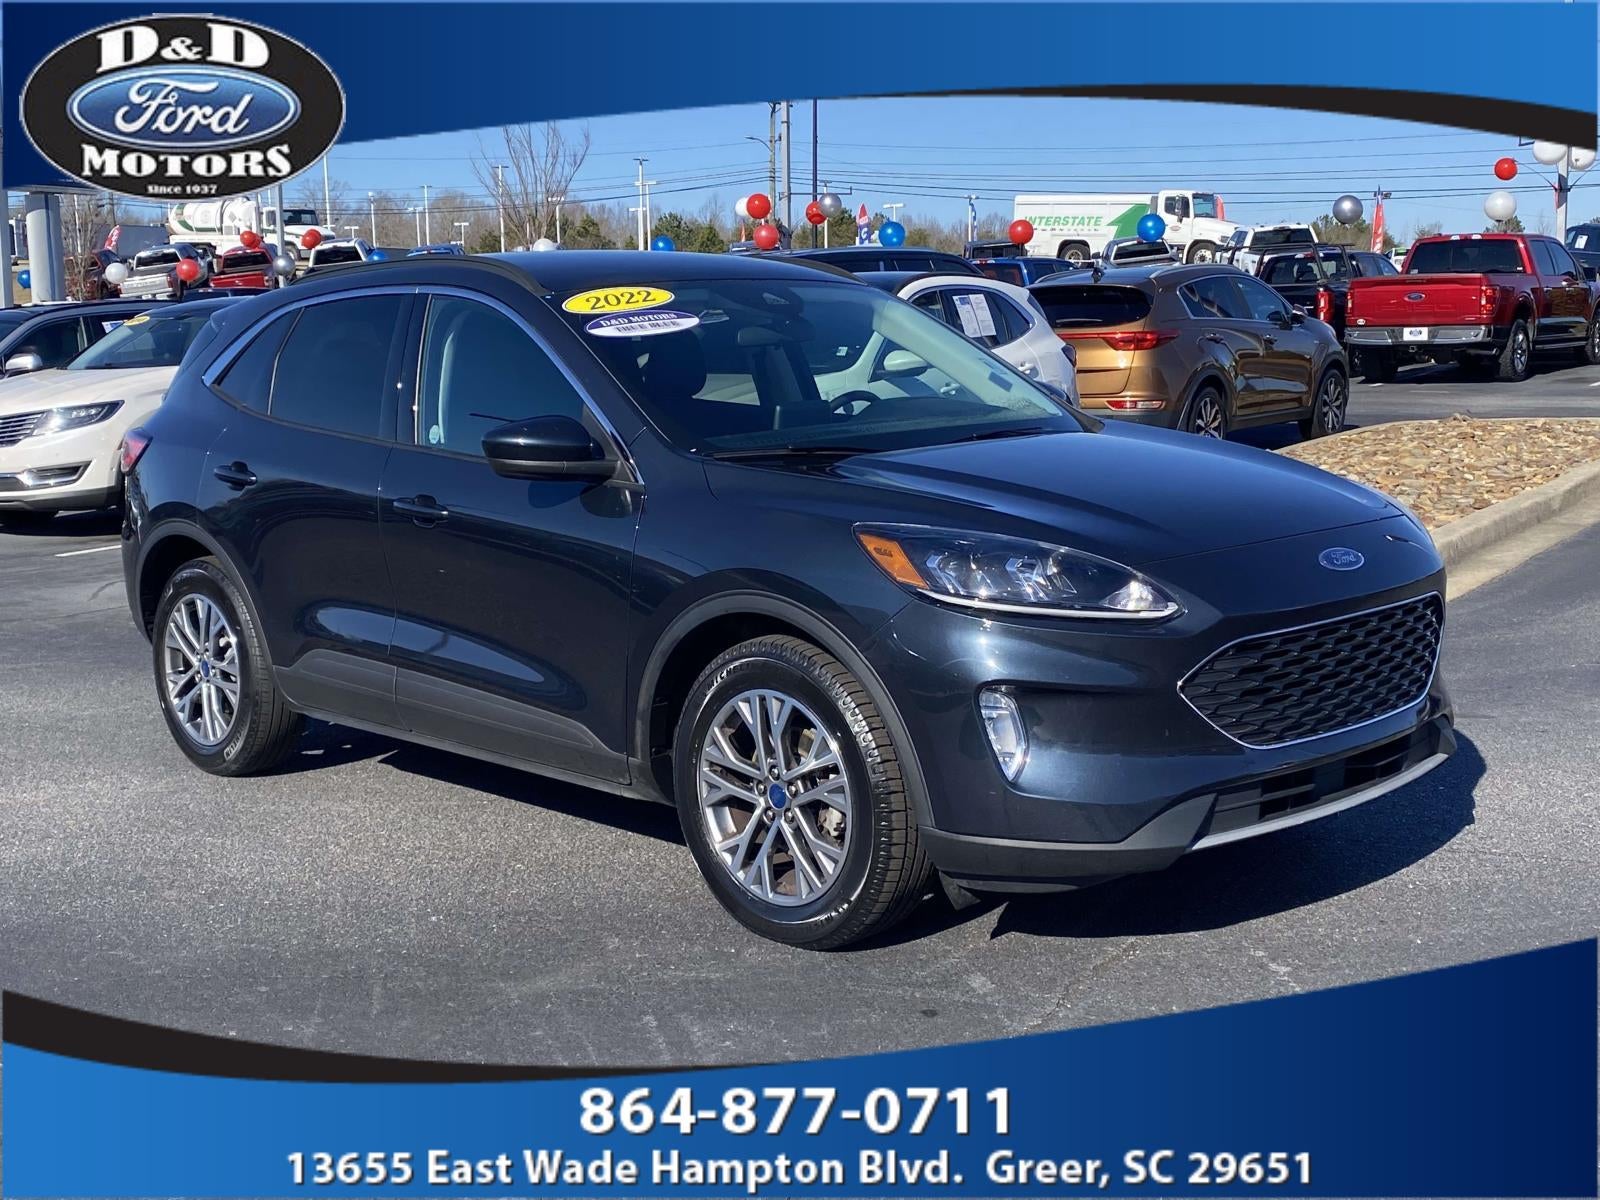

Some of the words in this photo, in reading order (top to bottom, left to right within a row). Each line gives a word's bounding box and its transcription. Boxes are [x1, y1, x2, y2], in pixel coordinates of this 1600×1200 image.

[585, 290, 656, 310] 2022
[599, 317, 629, 327] D&D
[630, 313, 678, 323] MOTORS
[1331, 551, 1356, 564] Ford
